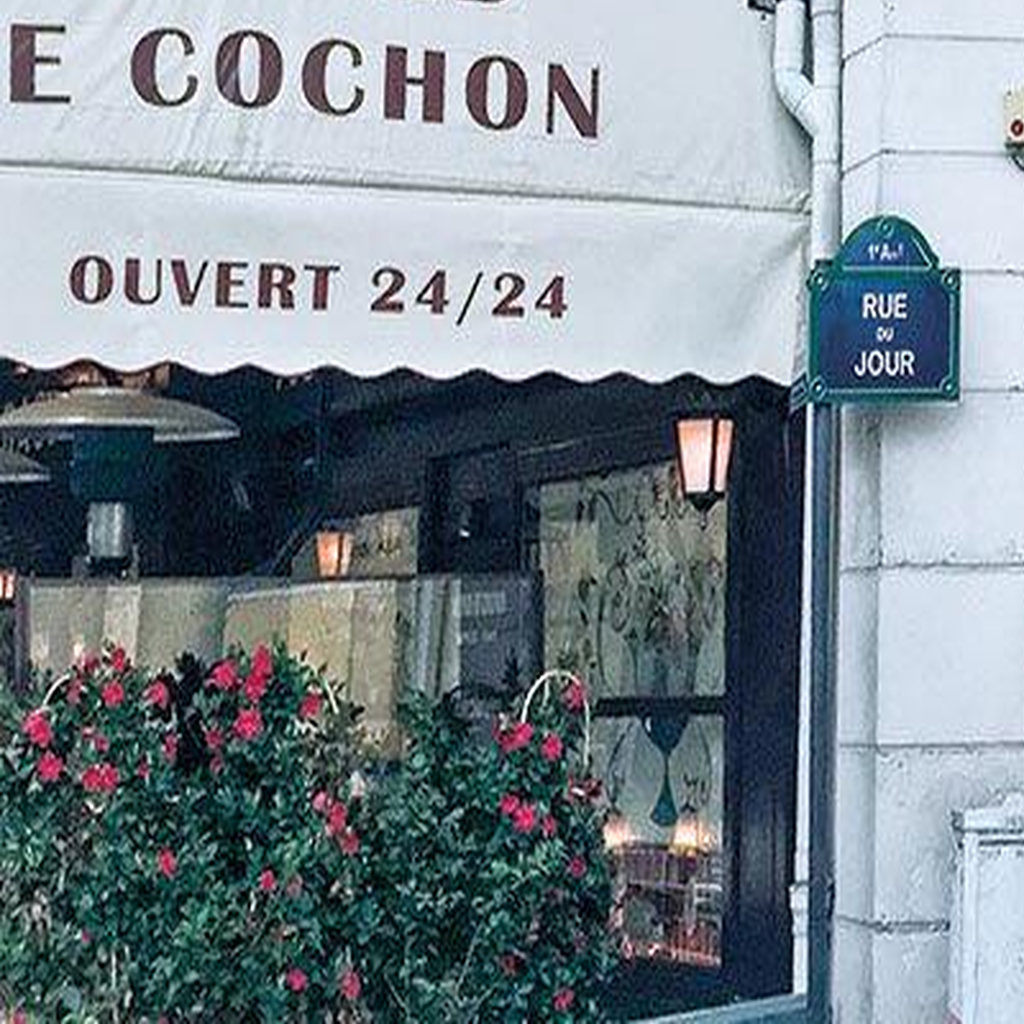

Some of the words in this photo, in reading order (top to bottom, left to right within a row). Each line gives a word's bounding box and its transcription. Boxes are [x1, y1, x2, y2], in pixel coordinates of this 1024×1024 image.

[130, 27, 602, 140] COCHON
[69, 254, 341, 312] OUVERT
[369, 267, 570, 326] 24/24
[862, 293, 907, 319] RUE
[854, 350, 915, 377] JOUR
